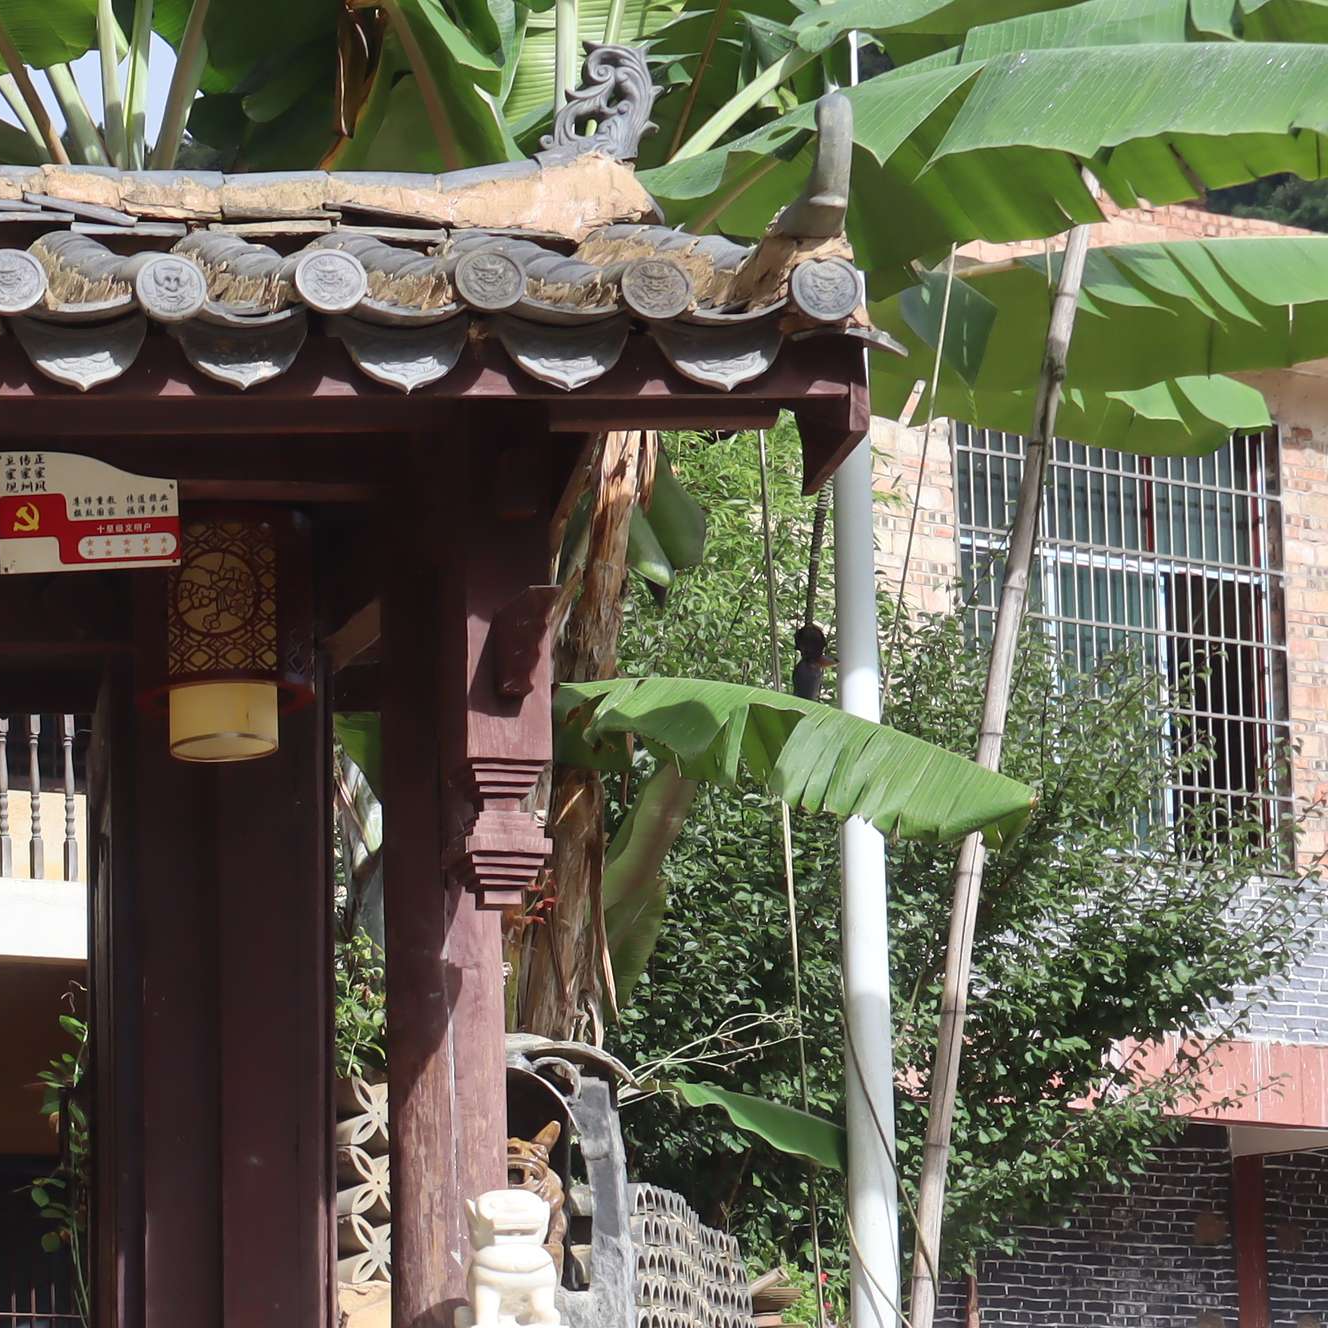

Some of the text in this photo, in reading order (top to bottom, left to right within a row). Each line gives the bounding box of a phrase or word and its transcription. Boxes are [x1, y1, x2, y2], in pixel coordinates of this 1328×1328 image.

[96, 522, 152, 534] 十星级文明户
